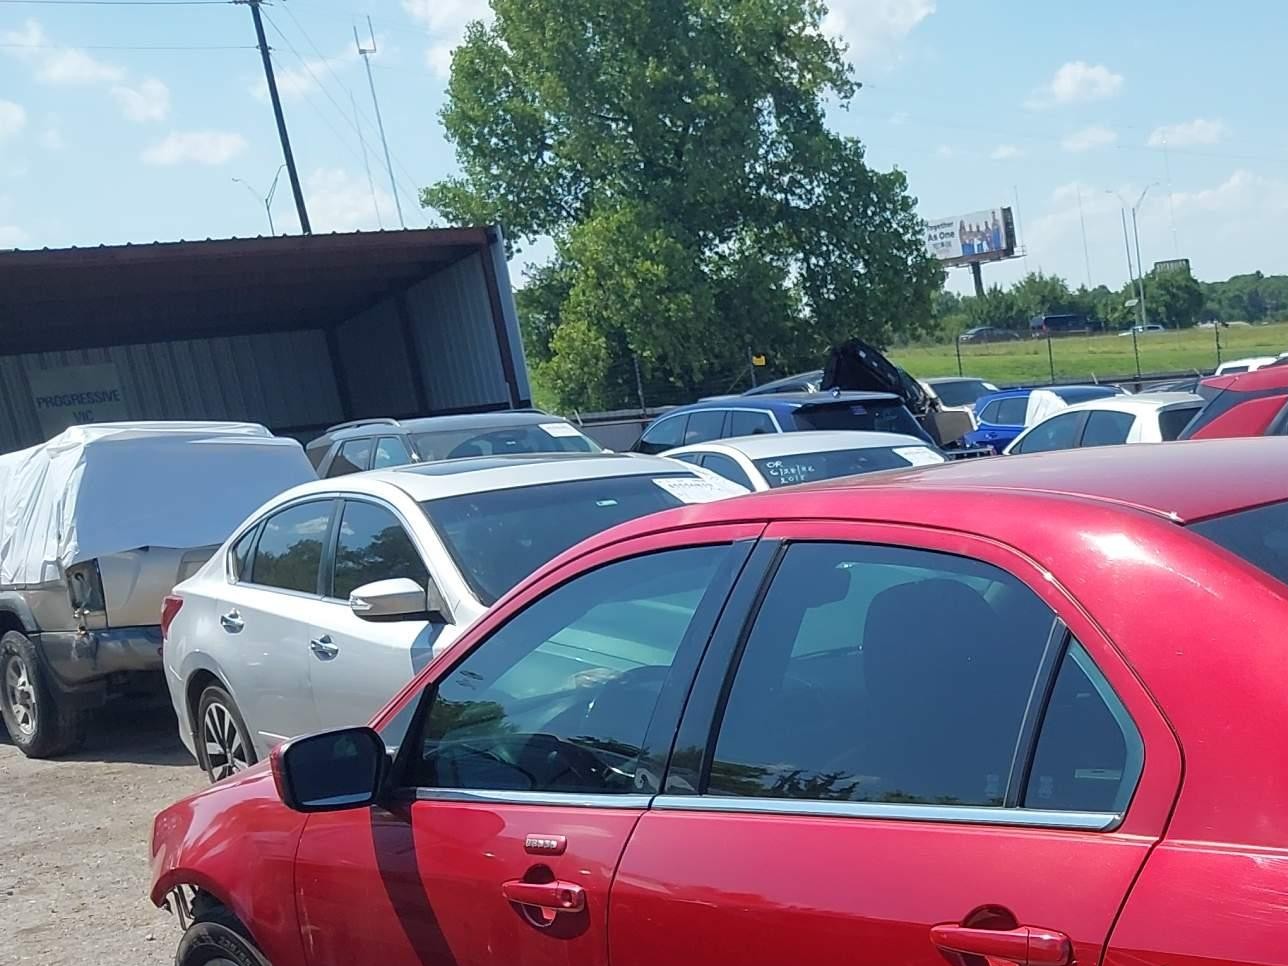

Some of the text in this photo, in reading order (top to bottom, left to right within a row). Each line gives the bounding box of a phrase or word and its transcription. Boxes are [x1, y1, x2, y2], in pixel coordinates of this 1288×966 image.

[928, 231, 955, 242] As One
[35, 389, 121, 409] PROGRESSIVE
